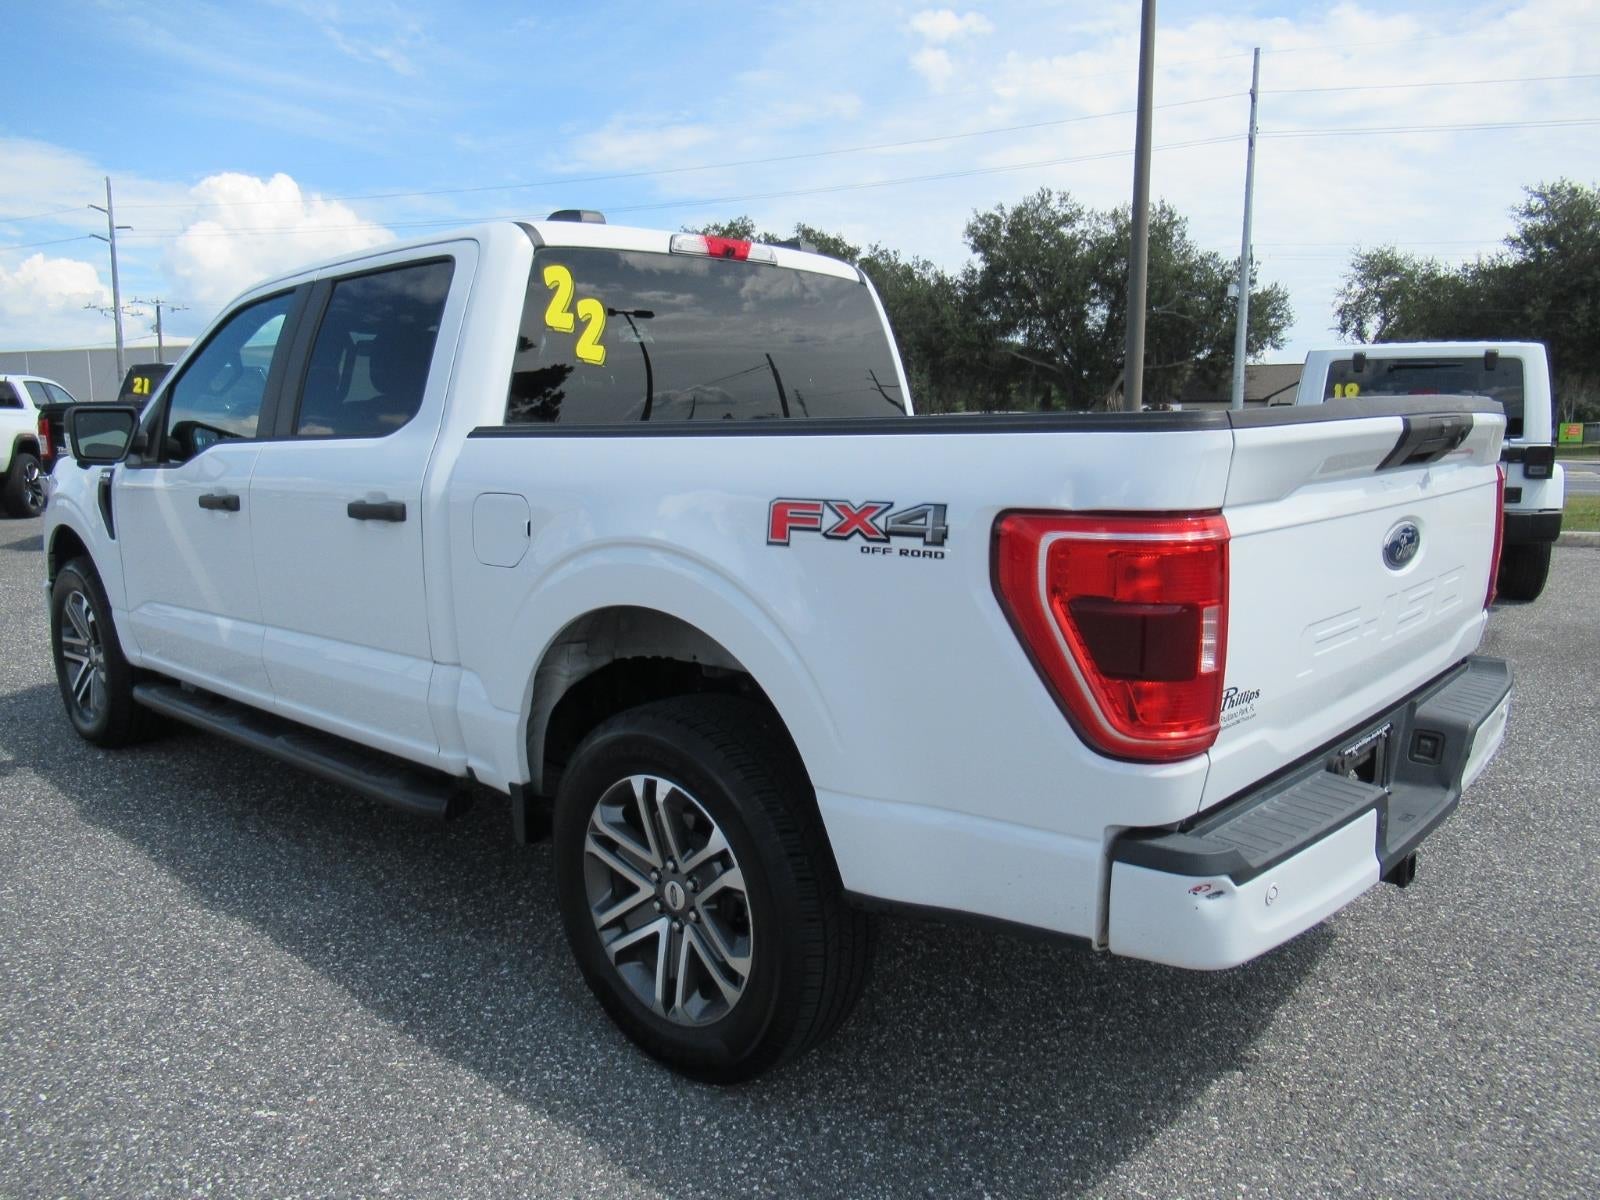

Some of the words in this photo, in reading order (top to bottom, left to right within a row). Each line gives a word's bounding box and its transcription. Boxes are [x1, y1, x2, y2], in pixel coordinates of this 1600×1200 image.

[543, 265, 606, 366] 22
[132, 377, 150, 394] 21
[766, 497, 949, 547] FX4
[860, 546, 893, 555] OFF
[899, 548, 945, 560] ROAD
[1221, 686, 1261, 712] Phillips
